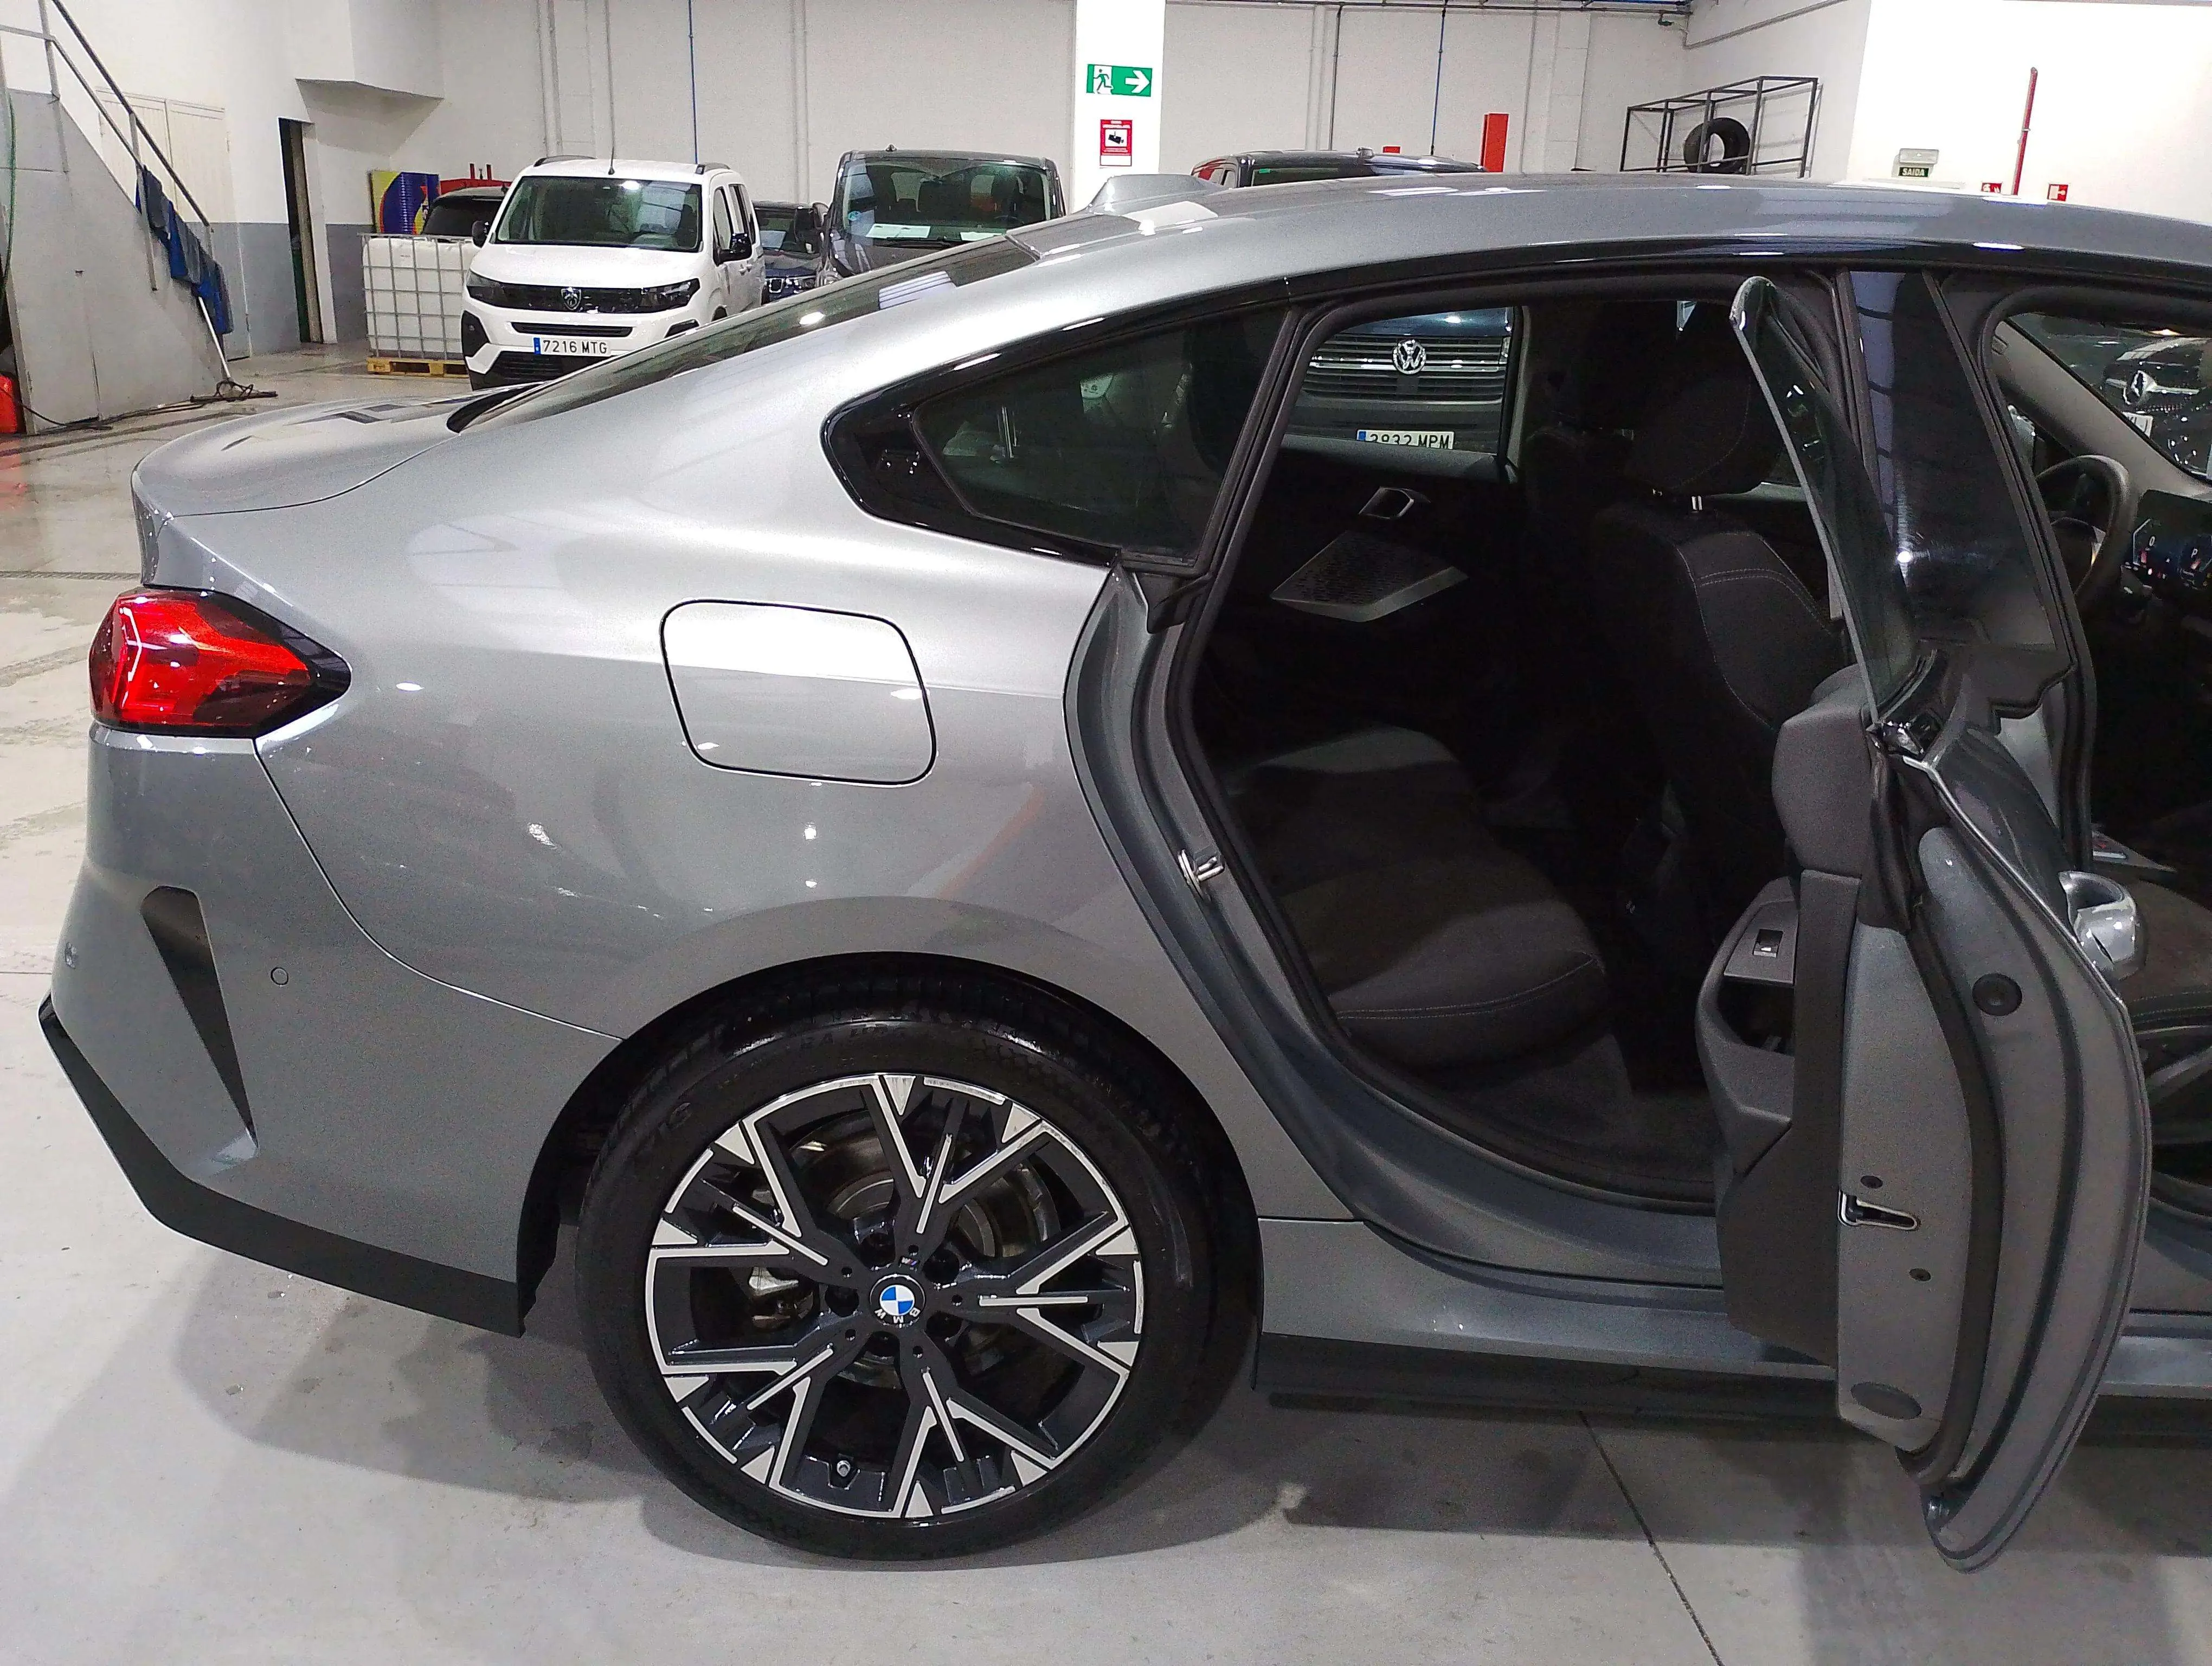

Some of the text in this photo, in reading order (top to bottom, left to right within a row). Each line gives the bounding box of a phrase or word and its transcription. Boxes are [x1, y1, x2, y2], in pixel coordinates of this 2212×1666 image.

[543, 340, 577, 353] 7216
[582, 341, 607, 354] MTG
[1418, 434, 1450, 449] MPM
[874, 1307, 921, 1324] BMW
